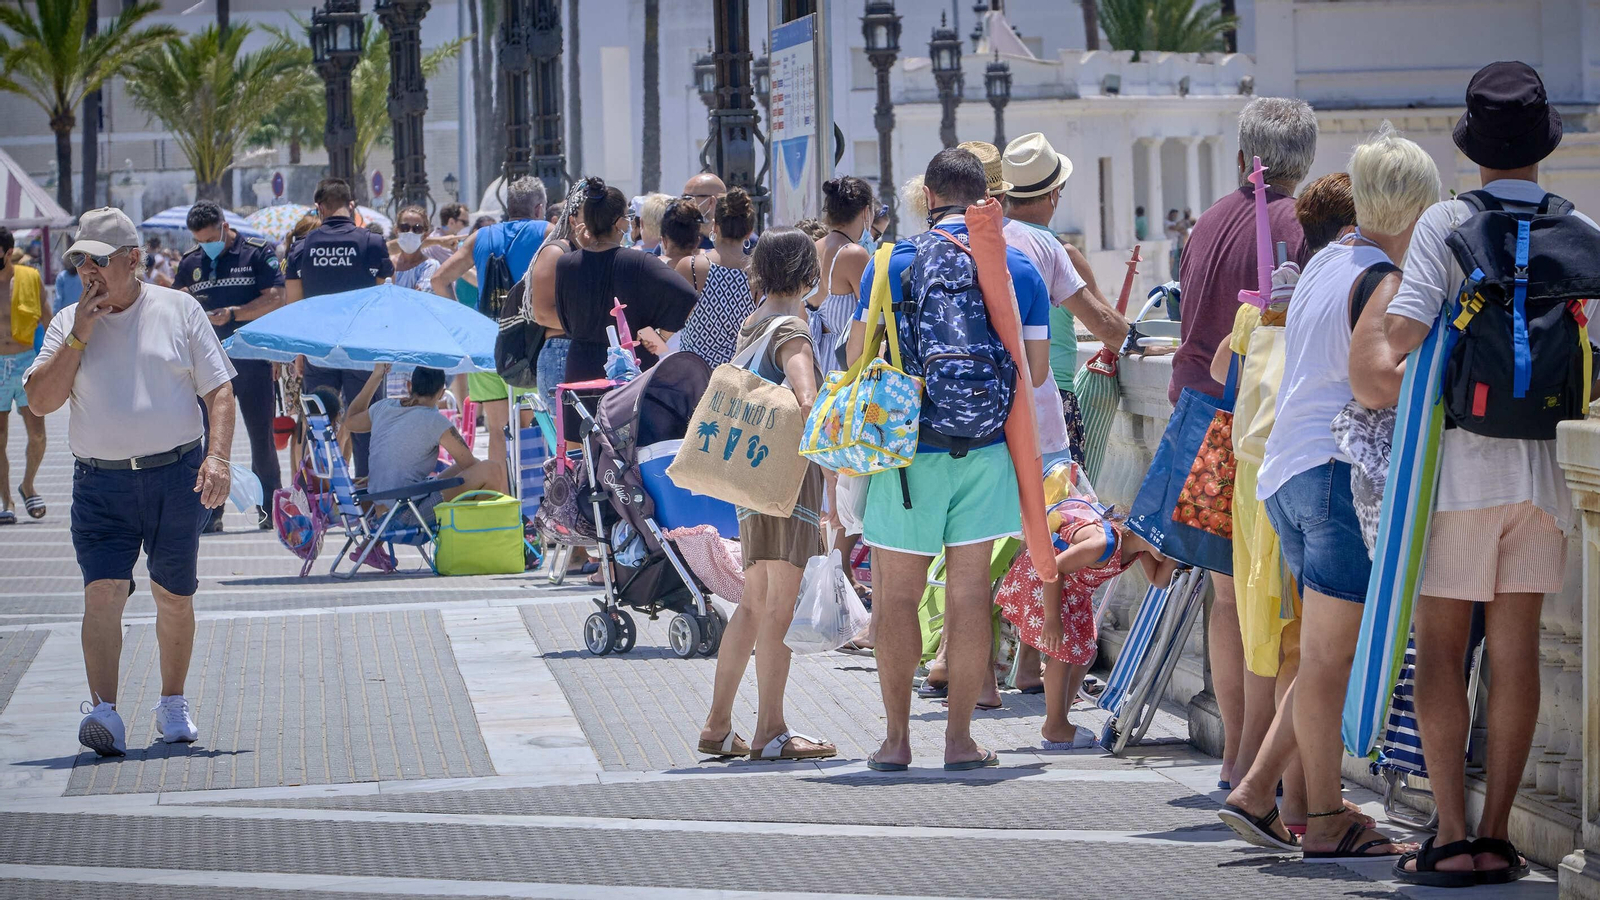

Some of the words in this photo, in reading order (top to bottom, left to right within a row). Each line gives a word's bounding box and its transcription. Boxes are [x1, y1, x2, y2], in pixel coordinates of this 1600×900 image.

[309, 247, 357, 257] POLICIA
[313, 257, 353, 267] LOCAL
[708, 390, 726, 413] ALL
[723, 396, 744, 420] YOU
[742, 402, 766, 426] NEED
[766, 407, 779, 430] IS
